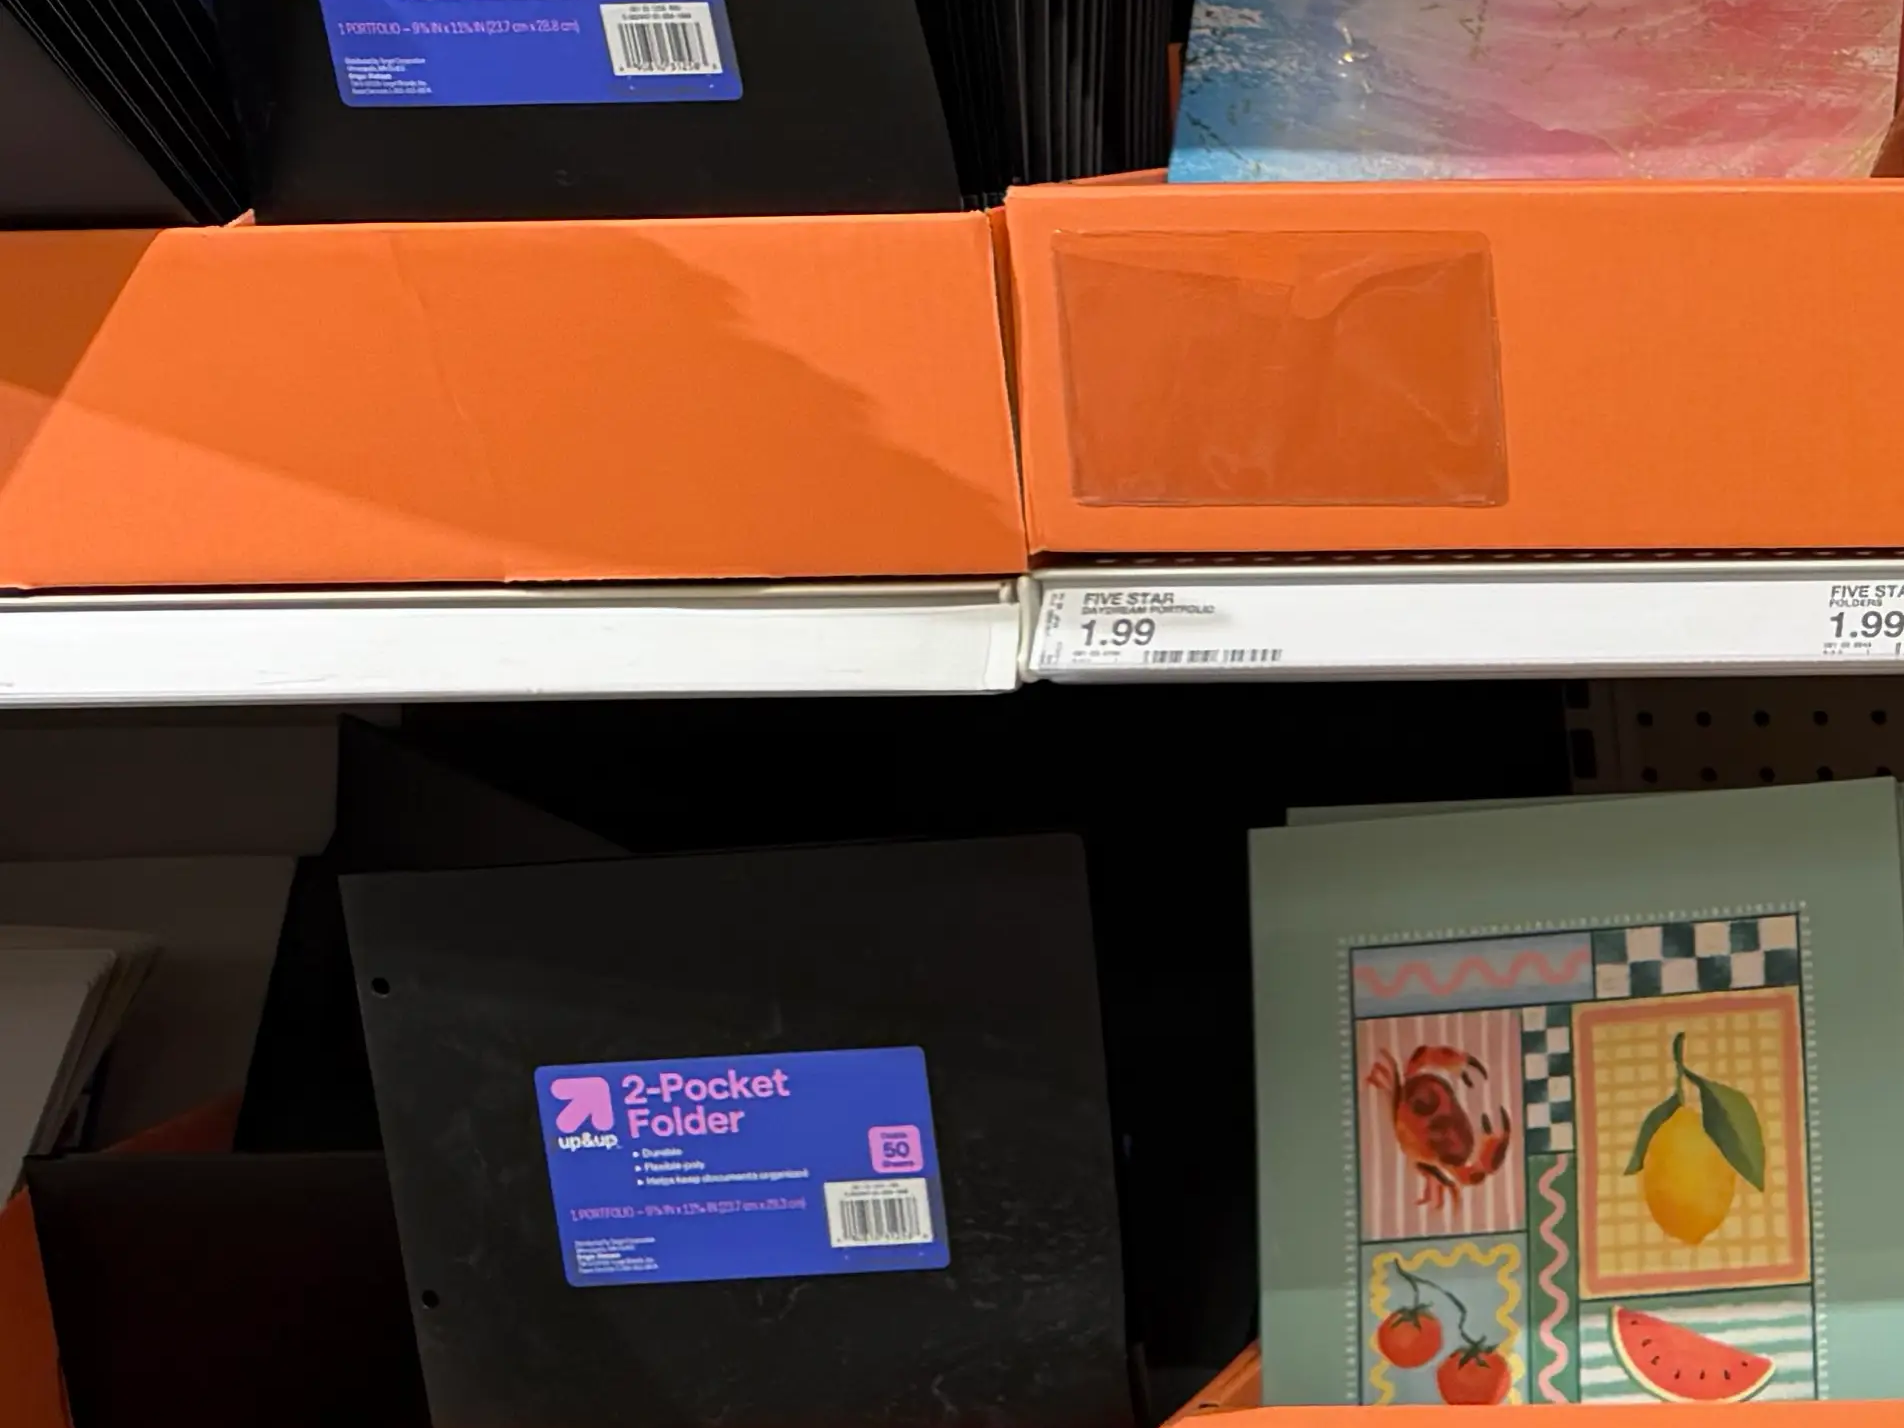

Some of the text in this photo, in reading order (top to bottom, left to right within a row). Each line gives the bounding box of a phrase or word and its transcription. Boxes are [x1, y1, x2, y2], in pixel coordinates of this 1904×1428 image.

[1083, 592, 1174, 605] FIVE STAR
[1831, 585, 1869, 598] FIVE
[1081, 618, 1155, 646] 1.99
[1830, 610, 1904, 638] 1.99
[622, 1068, 791, 1104] 2-Pocket
[628, 1105, 745, 1138] Folder
[558, 1132, 618, 1151] up&up
[883, 1141, 909, 1159] 50
